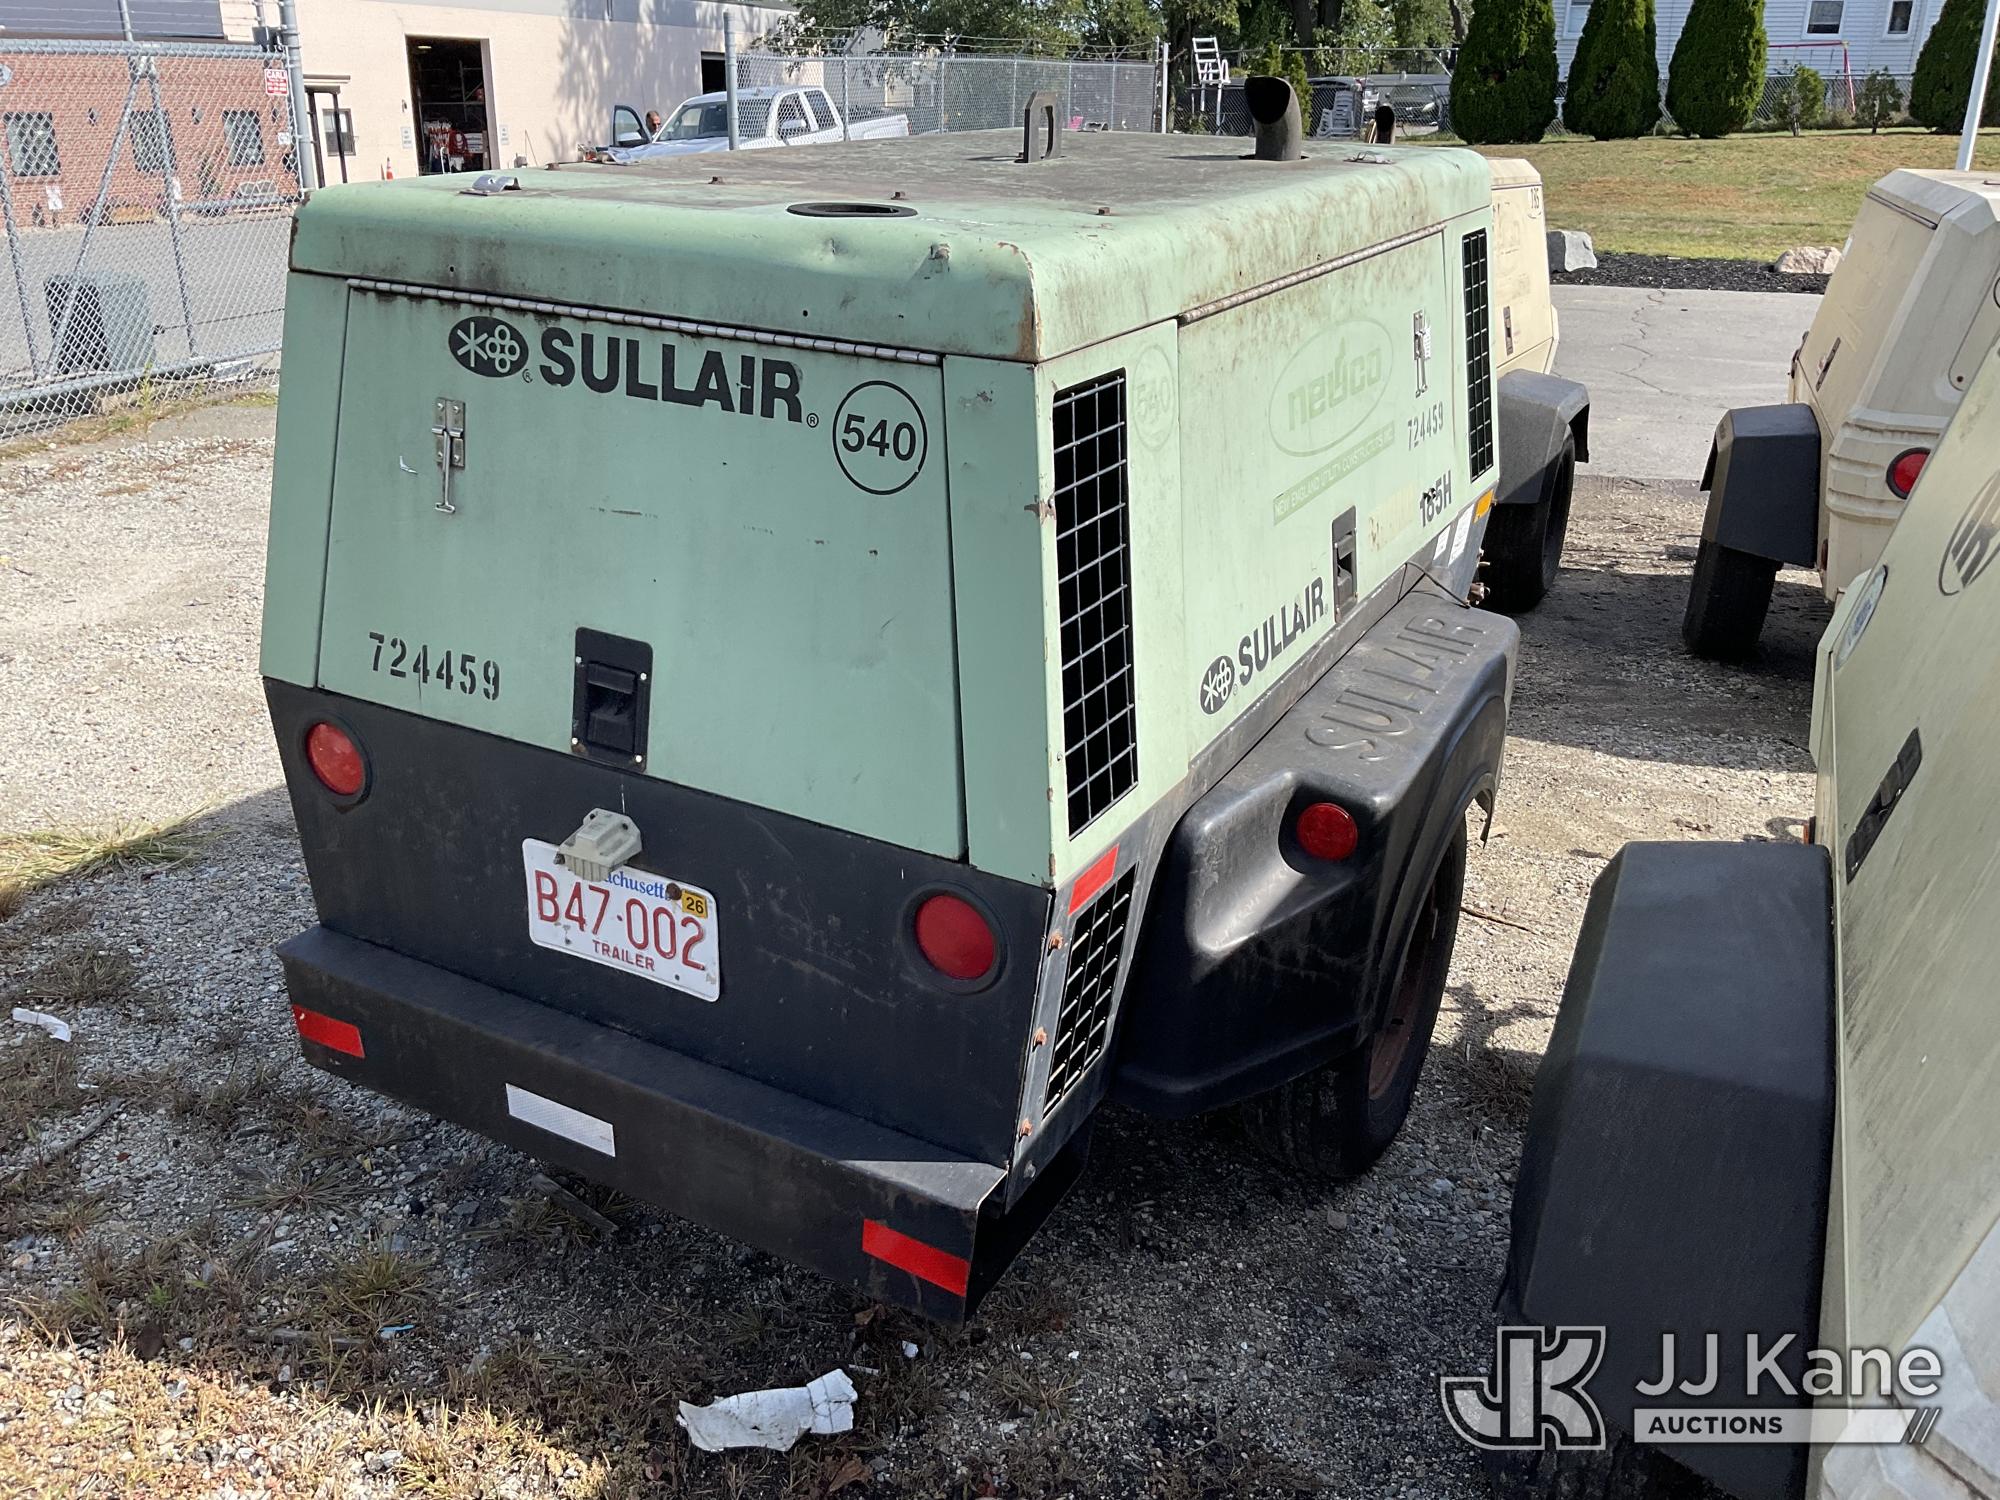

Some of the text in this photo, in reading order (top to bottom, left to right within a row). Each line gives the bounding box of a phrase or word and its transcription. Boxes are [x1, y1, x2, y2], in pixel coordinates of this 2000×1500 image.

[540, 327, 802, 423] SULLAIR
[841, 413, 917, 461] 540
[1408, 401, 1444, 450] 724459
[1238, 576, 1324, 687] SULLAIR
[369, 631, 500, 701] 724459
[1304, 613, 1487, 763] SULLAIR
[685, 896, 705, 915] 26
[592, 939, 656, 972] TRAILER
